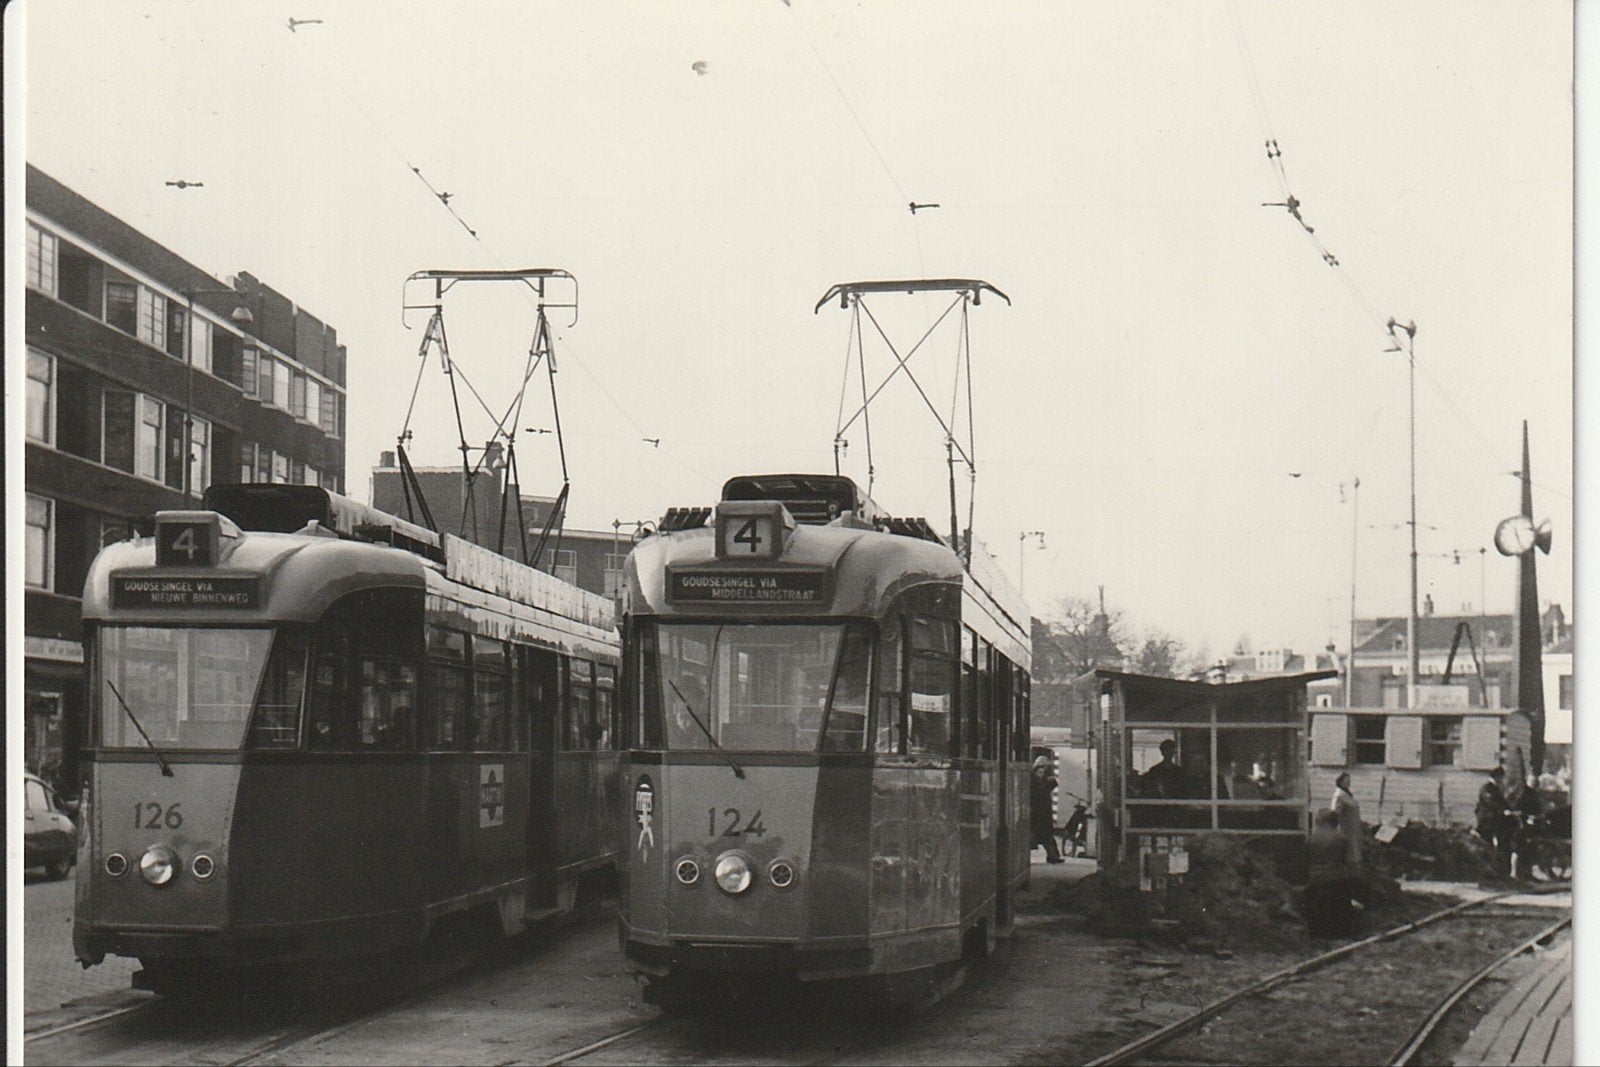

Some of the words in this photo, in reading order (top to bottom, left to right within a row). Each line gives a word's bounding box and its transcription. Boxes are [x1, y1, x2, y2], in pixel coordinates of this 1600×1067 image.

[172, 527, 199, 560] 4
[733, 517, 762, 553] 4
[124, 580, 192, 592] GOUDSESINGEL
[197, 581, 213, 592] VIA
[682, 576, 756, 588] GOUDSESINGEL
[760, 577, 777, 588] VIA
[151, 592, 187, 604] NIEUWE
[192, 592, 249, 604] BINNENWEG
[711, 588, 815, 600] MIDDELLANDSTRAAT
[134, 801, 184, 830] 126
[708, 806, 768, 838] 124
